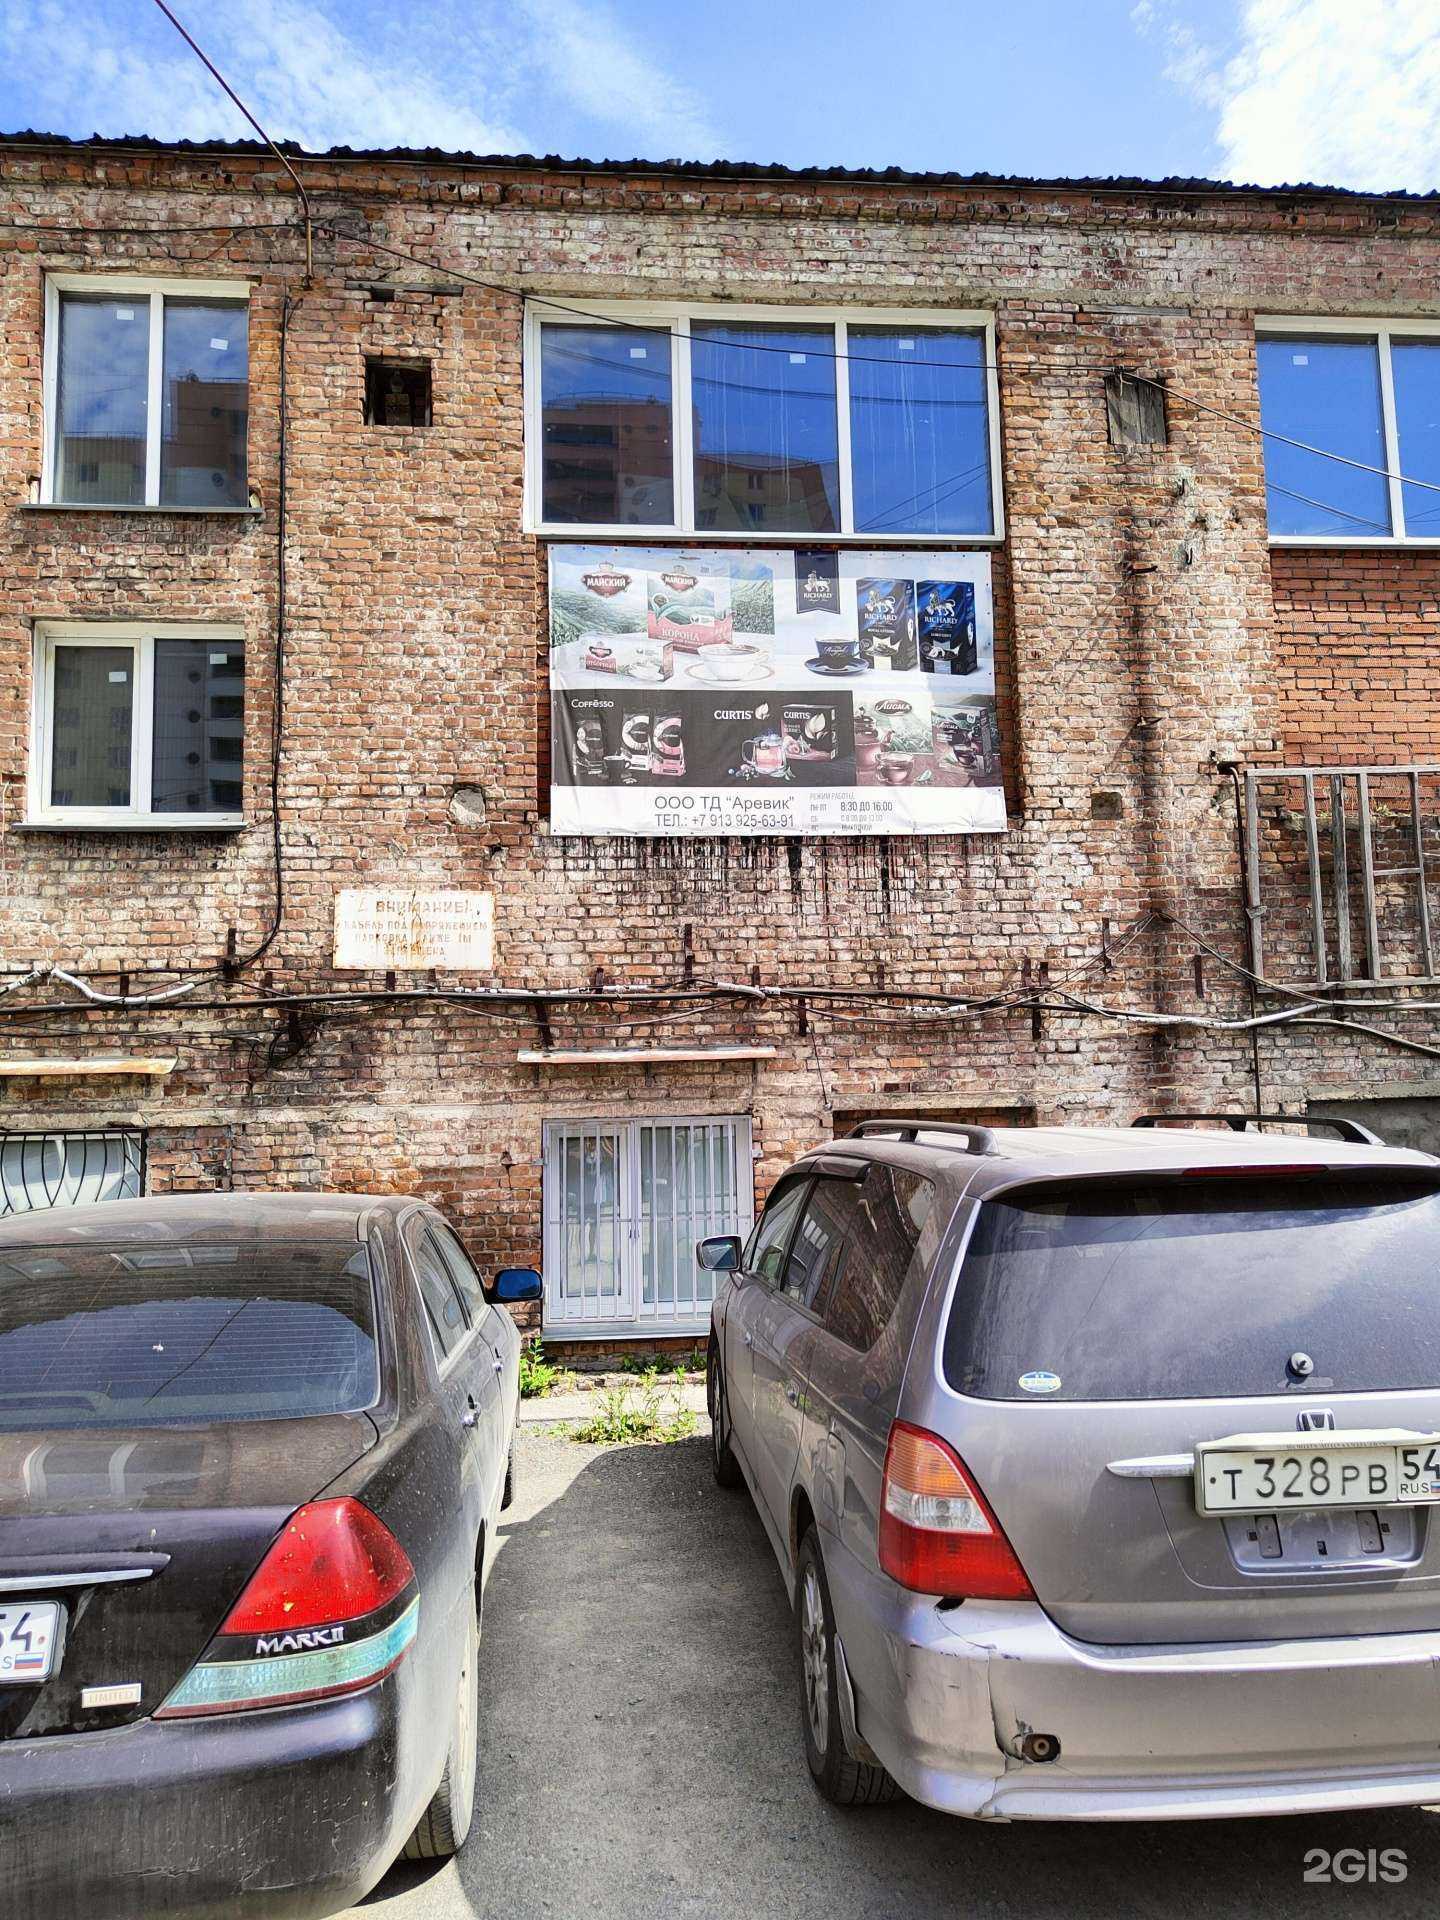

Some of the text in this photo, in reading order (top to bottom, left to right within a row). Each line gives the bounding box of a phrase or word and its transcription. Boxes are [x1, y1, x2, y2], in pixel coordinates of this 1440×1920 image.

[586, 577, 626, 587] МАЙСКИЙ
[864, 613, 898, 621] RICHARD
[925, 616, 958, 625] RICHARD
[662, 627, 700, 642] КОРОНА
[714, 710, 752, 720] CURTIS
[784, 711, 811, 720] CURTIS
[655, 796, 694, 809] ООО
[700, 796, 721, 812] ТД
[860, 802, 870, 812] ДО
[655, 814, 794, 828] ТЕЛ.: +7 913 925-63-91
[1402, 1449, 1440, 1480] 54
[1400, 1482, 1430, 1494] RUS
